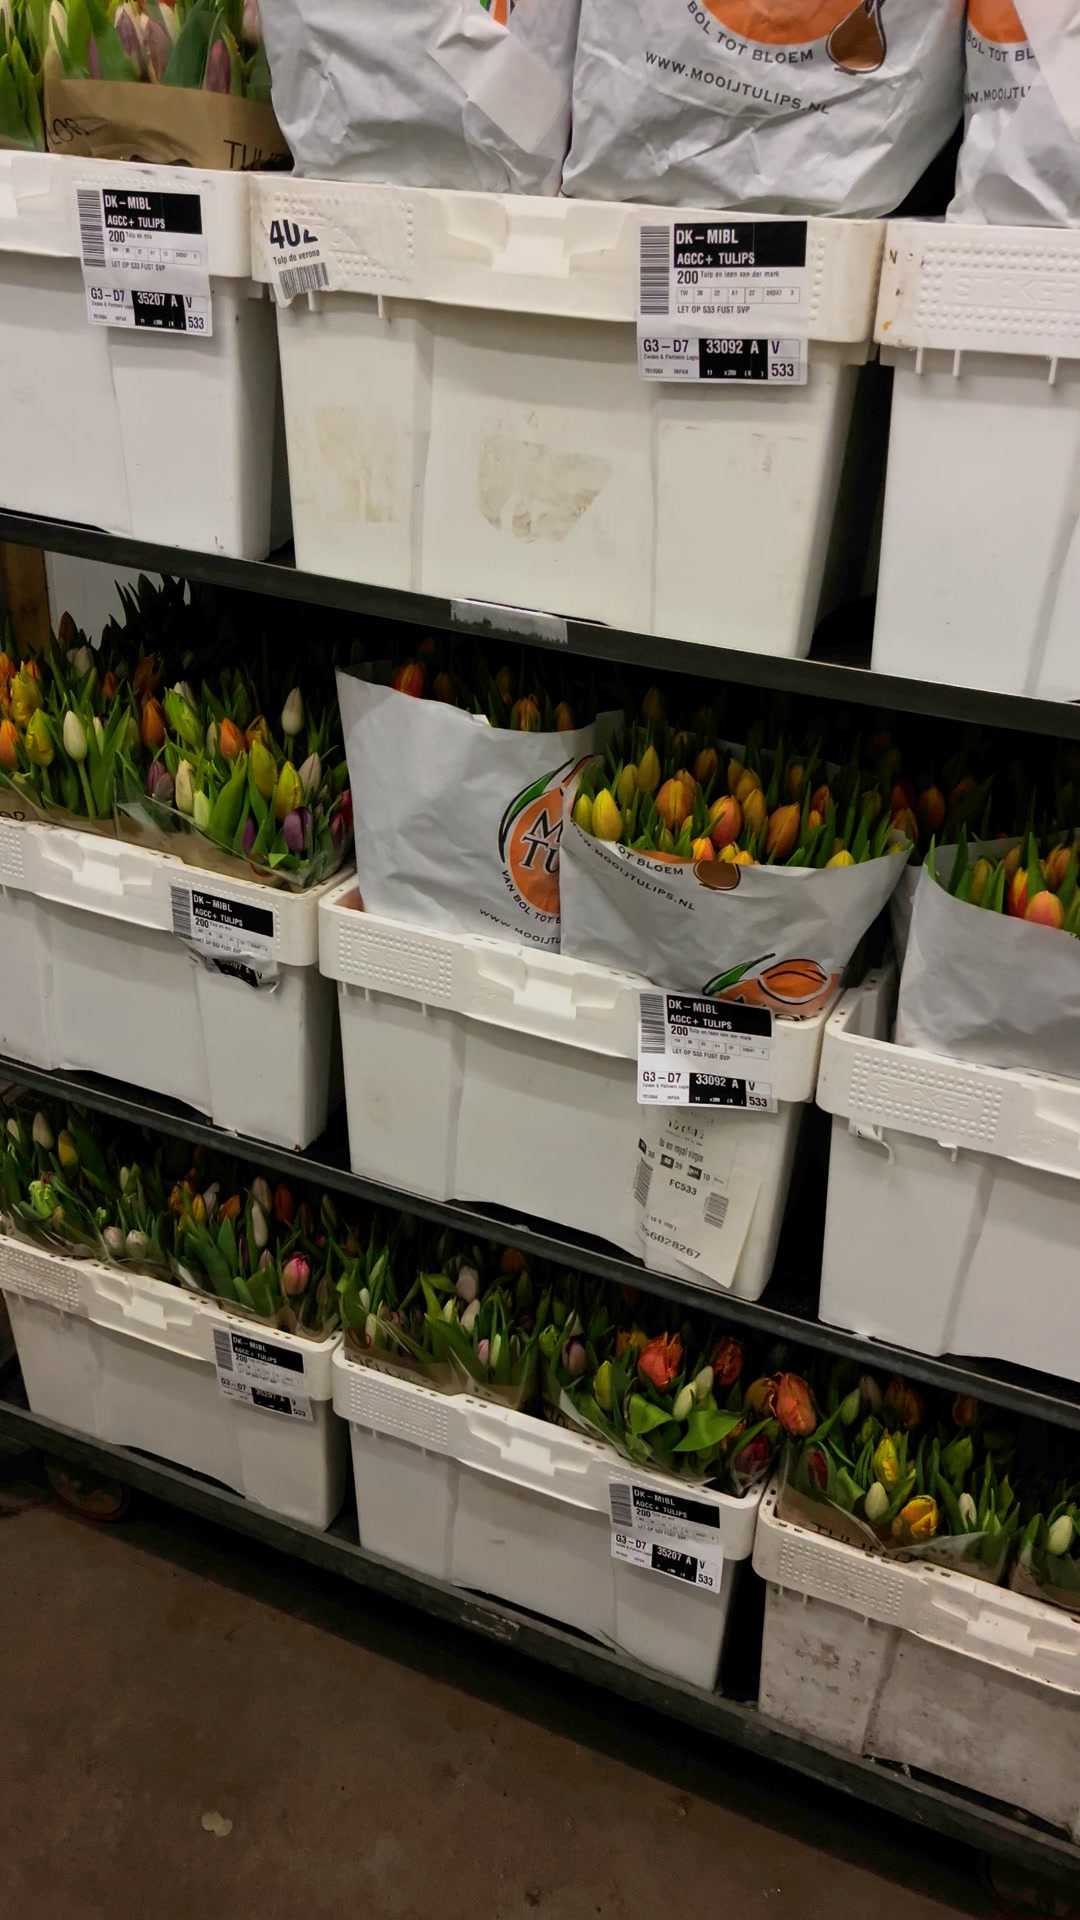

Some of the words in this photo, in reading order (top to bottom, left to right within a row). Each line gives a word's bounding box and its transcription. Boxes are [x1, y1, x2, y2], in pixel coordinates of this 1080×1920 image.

[687, 0, 711, 34] BOL
[716, 32, 748, 56] TOT
[752, 49, 814, 65] BLOEM
[989, 47, 1009, 62] TOT
[1015, 48, 1036, 62] BL
[645, 51, 830, 115] WWW.MOOIJTULIPS.NL
[108, 215, 135, 227] AGCC+
[138, 217, 166, 229] TULIPS
[108, 230, 125, 243] 200
[273, 255, 288, 265] Tulp
[288, 252, 298, 262] du
[298, 249, 320, 260] verona
[677, 252, 713, 265] AGCC+
[718, 252, 756, 265] TULIPS
[130, 262, 140, 270] 533
[677, 270, 699, 285] 200
[700, 271, 713, 279] Tulp
[137, 292, 166, 306] 35207
[170, 295, 178, 308] A
[185, 296, 192, 308] V
[677, 306, 689, 314] LET
[691, 306, 701, 314] OP
[702, 306, 715, 314] 533
[717, 306, 734, 314] FUST
[736, 306, 750, 314] SVP
[188, 316, 205, 330] 533
[706, 340, 744, 354] 33092
[750, 341, 760, 354] A
[771, 340, 780, 354] V
[771, 363, 795, 377] 533
[528, 809, 564, 843] M
[522, 836, 560, 874] TU
[637, 858, 684, 876] BLOEM
[502, 869, 515, 892] VAN
[513, 894, 531, 916] BOL
[534, 911, 551, 924] TOT
[195, 917, 209, 929] 200
[220, 914, 244, 927] TULIPS
[670, 1014, 698, 1026] AGCC+
[703, 1018, 732, 1030] TULIPS
[671, 1025, 689, 1036] 200
[692, 1050, 703, 1058] 533
[704, 1051, 718, 1059] FUST
[695, 1074, 726, 1087] 33092
[731, 1079, 739, 1089] A
[748, 1081, 756, 1091] V
[749, 1096, 768, 1108] 533
[669, 1178, 698, 1196] FC533
[640, 1222, 701, 1260] 356028267
[235, 1354, 248, 1363] 200
[257, 1353, 277, 1364] TULIPS
[293, 1408, 306, 1417] 533
[636, 1508, 651, 1518] 200
[663, 1507, 688, 1518] TULIPS
[657, 1546, 682, 1561] 35207
[685, 1556, 692, 1565] A
[699, 1560, 706, 1569] V
[698, 1574, 713, 1587] 533
